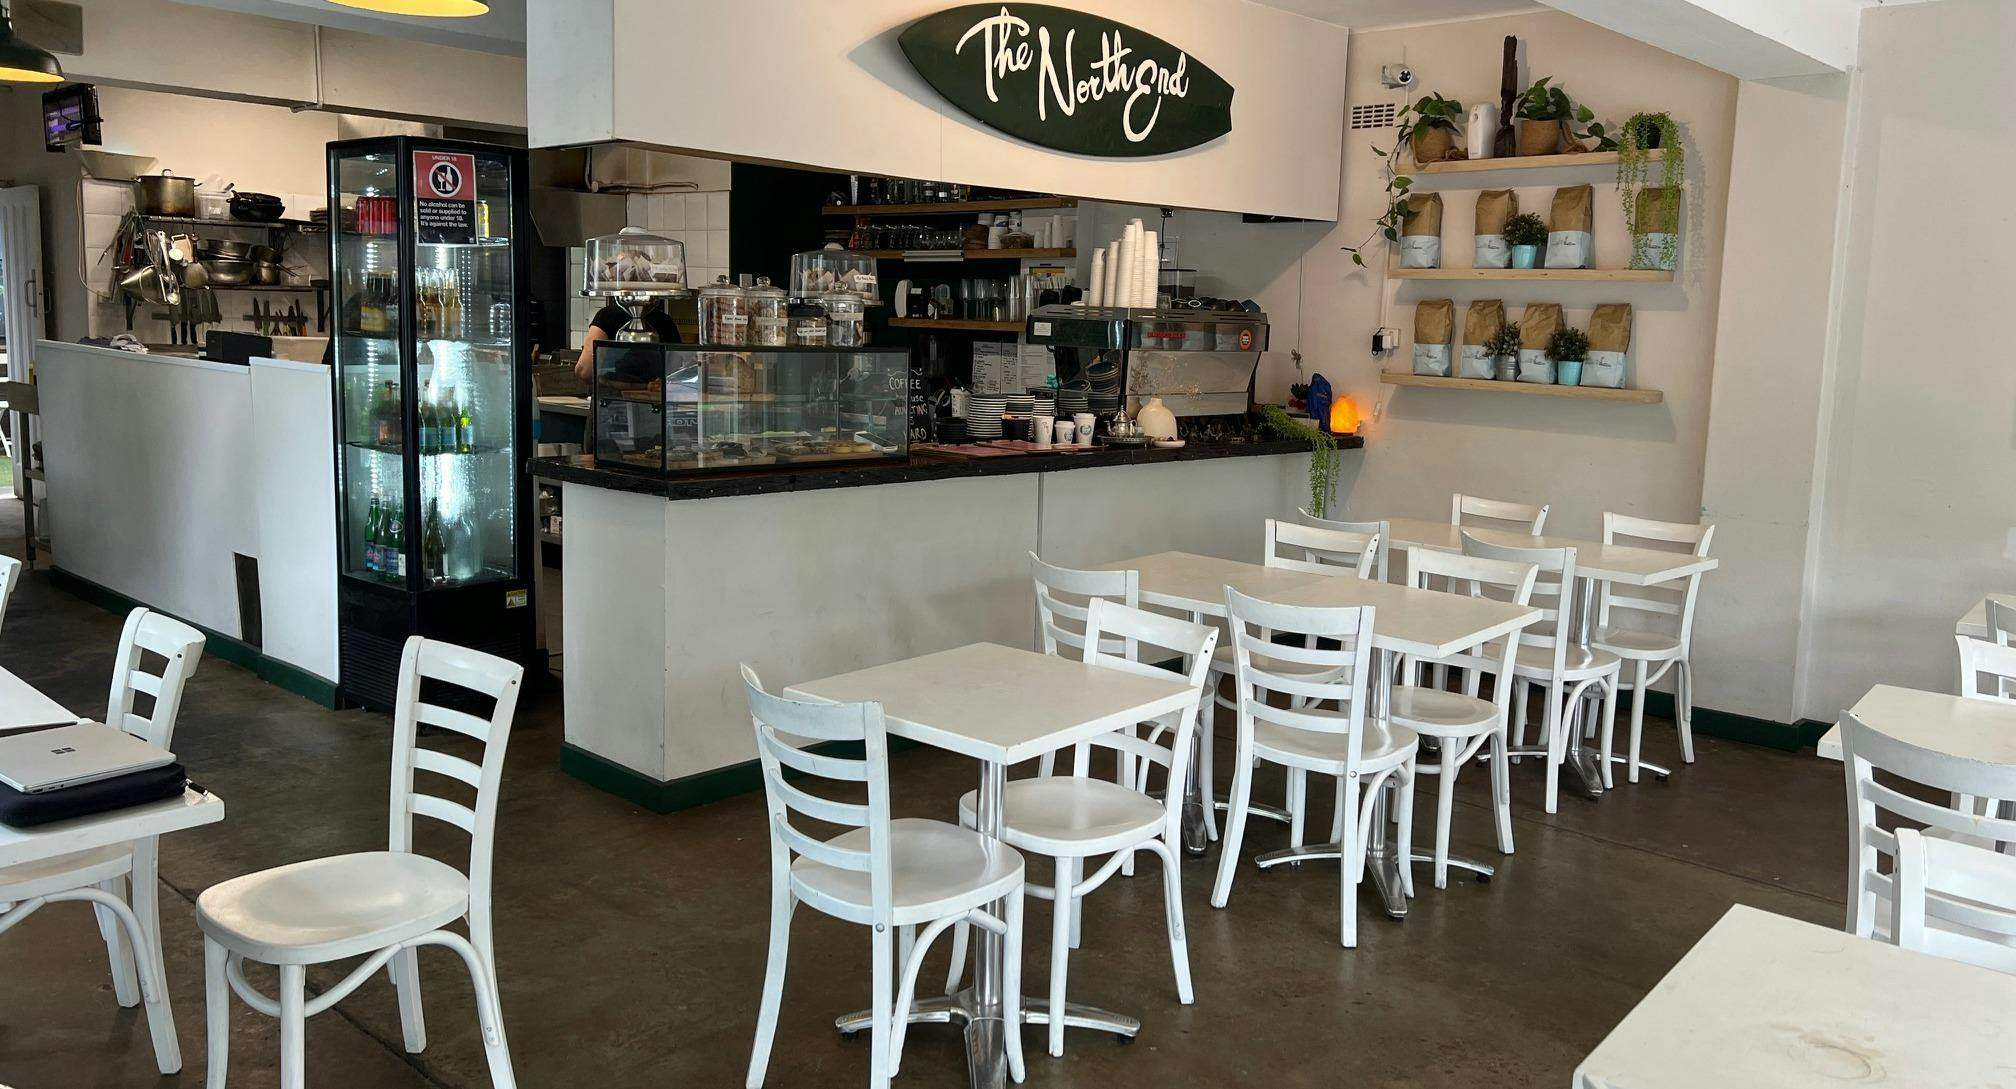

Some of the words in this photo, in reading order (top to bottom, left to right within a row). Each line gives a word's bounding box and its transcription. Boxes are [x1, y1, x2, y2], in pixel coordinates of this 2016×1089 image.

[955, 6, 1033, 103] The
[1038, 26, 1136, 121] North
[1122, 51, 1189, 143] End
[894, 402, 928, 416] ADTING
